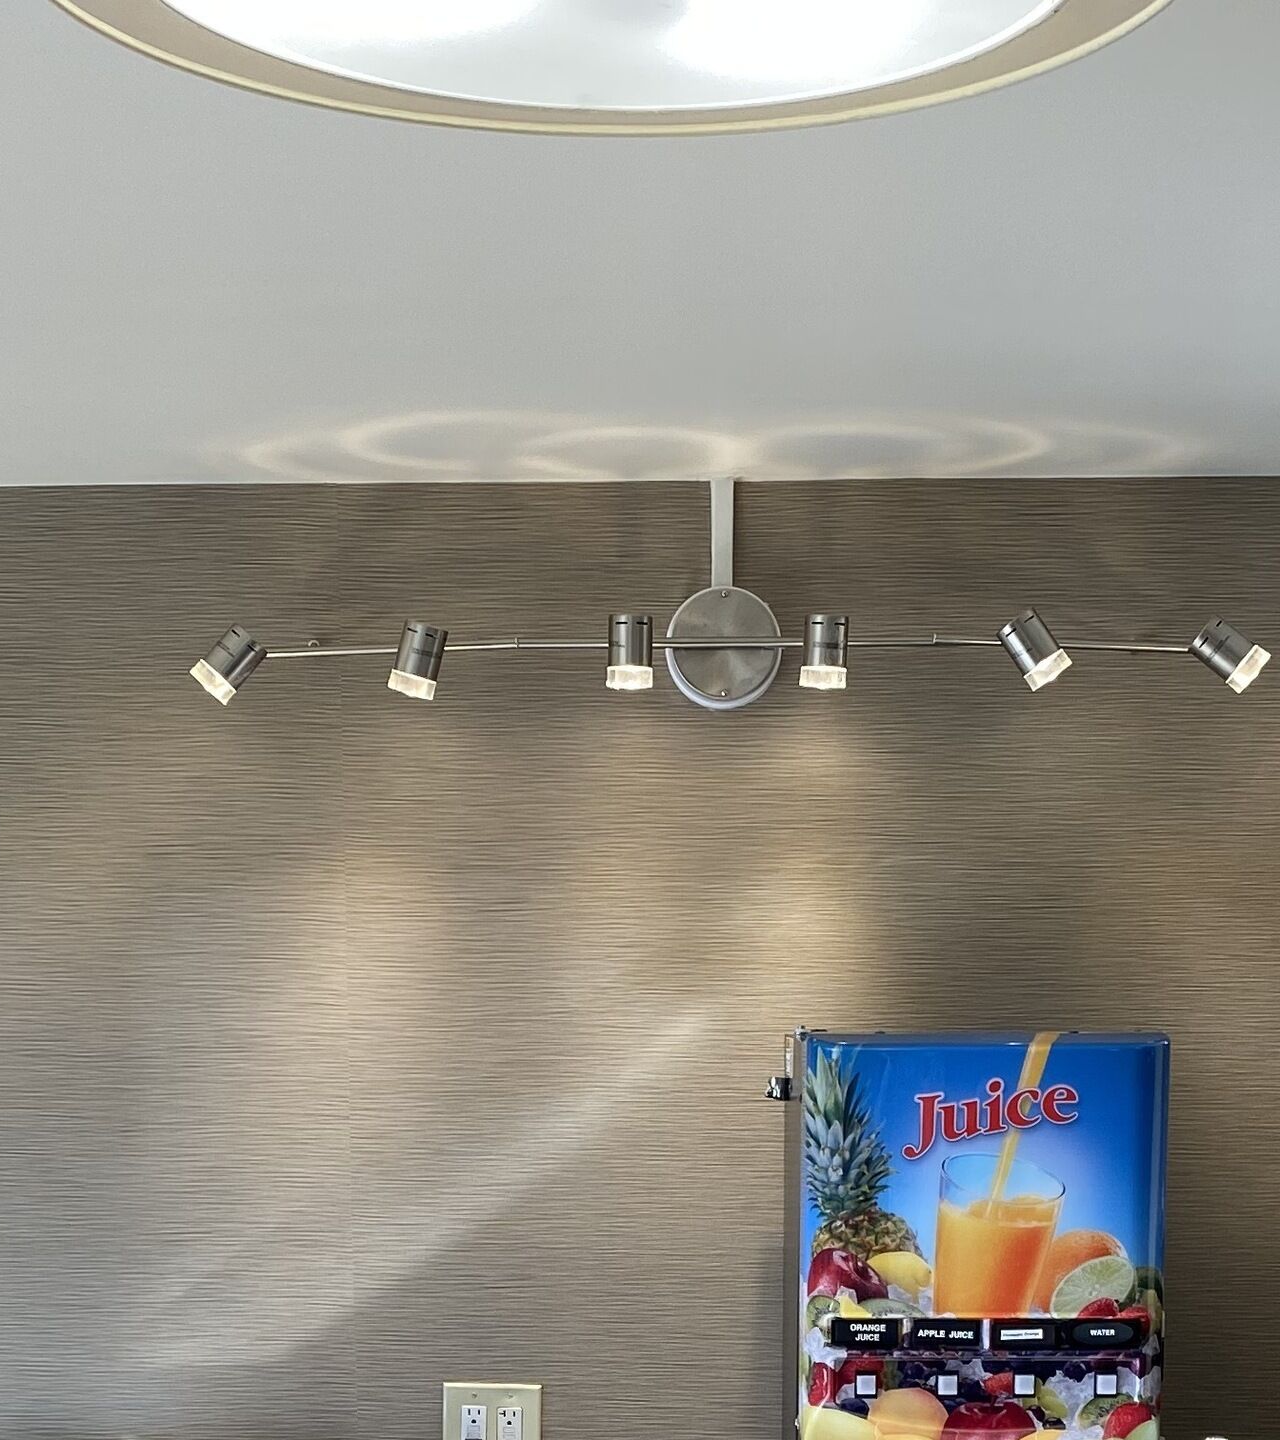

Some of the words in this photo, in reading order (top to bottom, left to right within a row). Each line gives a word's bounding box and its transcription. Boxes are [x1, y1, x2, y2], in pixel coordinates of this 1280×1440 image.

[902, 1077, 1078, 1160] Juice
[850, 1323, 887, 1332] ORANGE
[855, 1333, 880, 1341] JUICE
[917, 1329, 946, 1338] APPLE
[948, 1330, 974, 1339] JUICE
